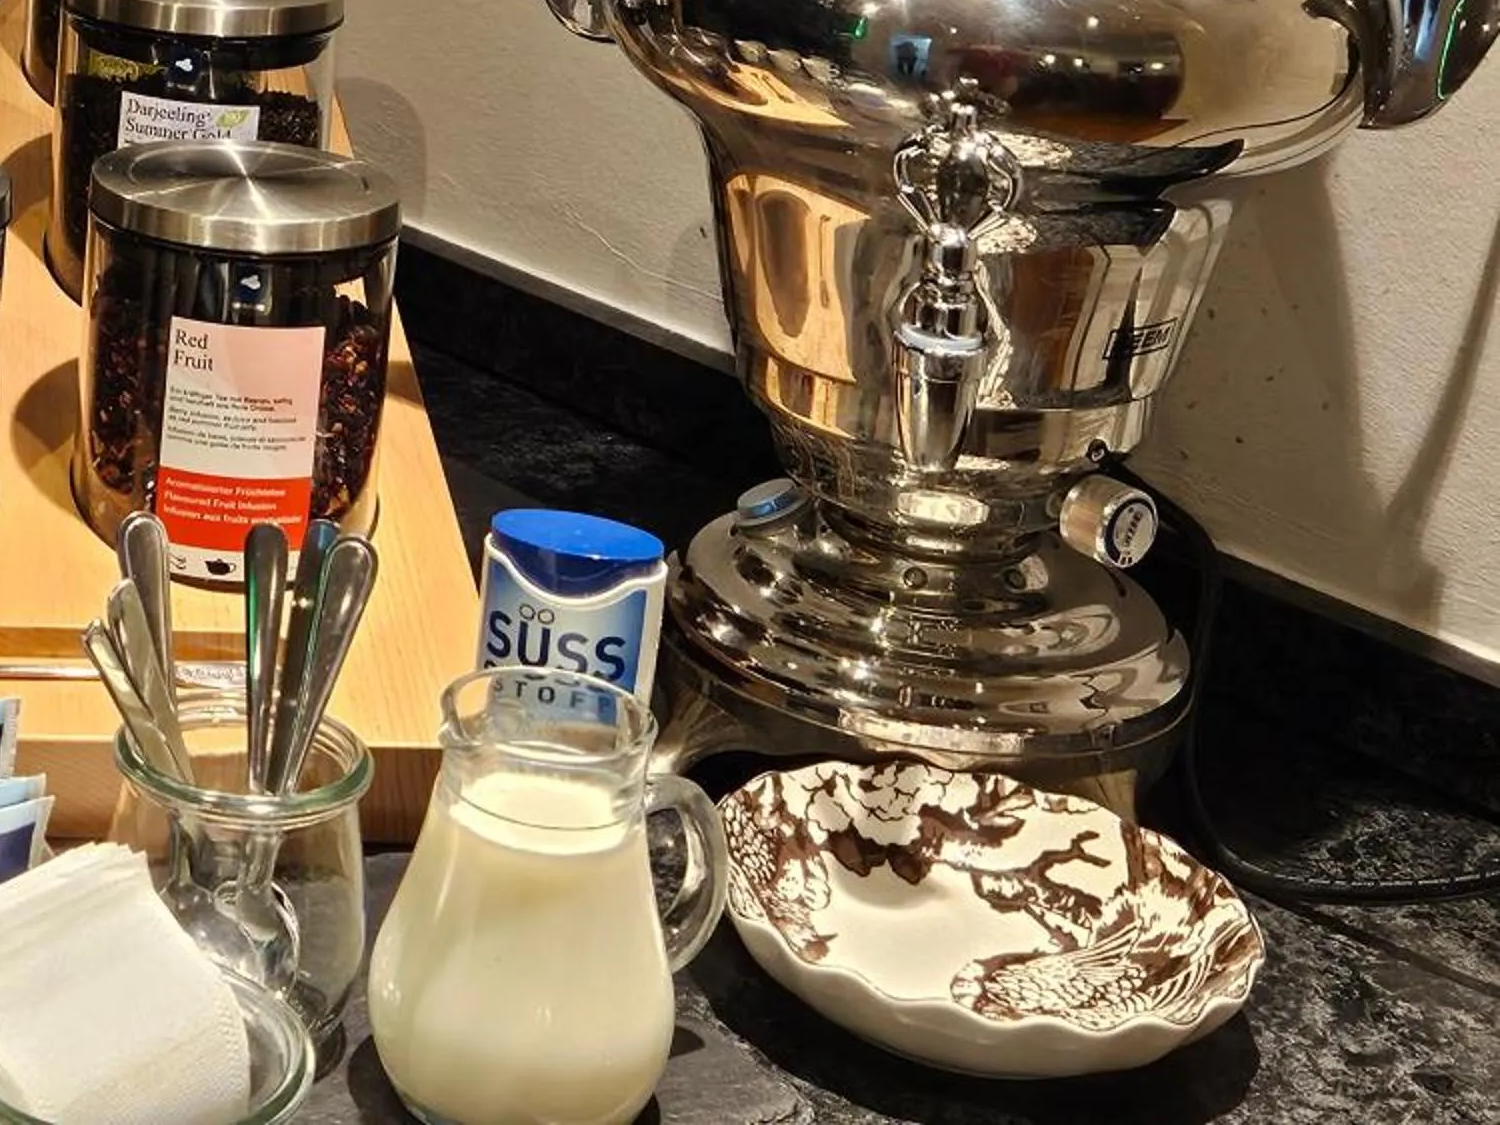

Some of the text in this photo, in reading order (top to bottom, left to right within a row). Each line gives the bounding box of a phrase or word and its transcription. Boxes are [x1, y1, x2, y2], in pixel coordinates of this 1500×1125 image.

[125, 116, 189, 141] Summer
[173, 327, 209, 350] Red
[173, 349, 214, 373] Fruit
[486, 602, 627, 683] SÜSS
